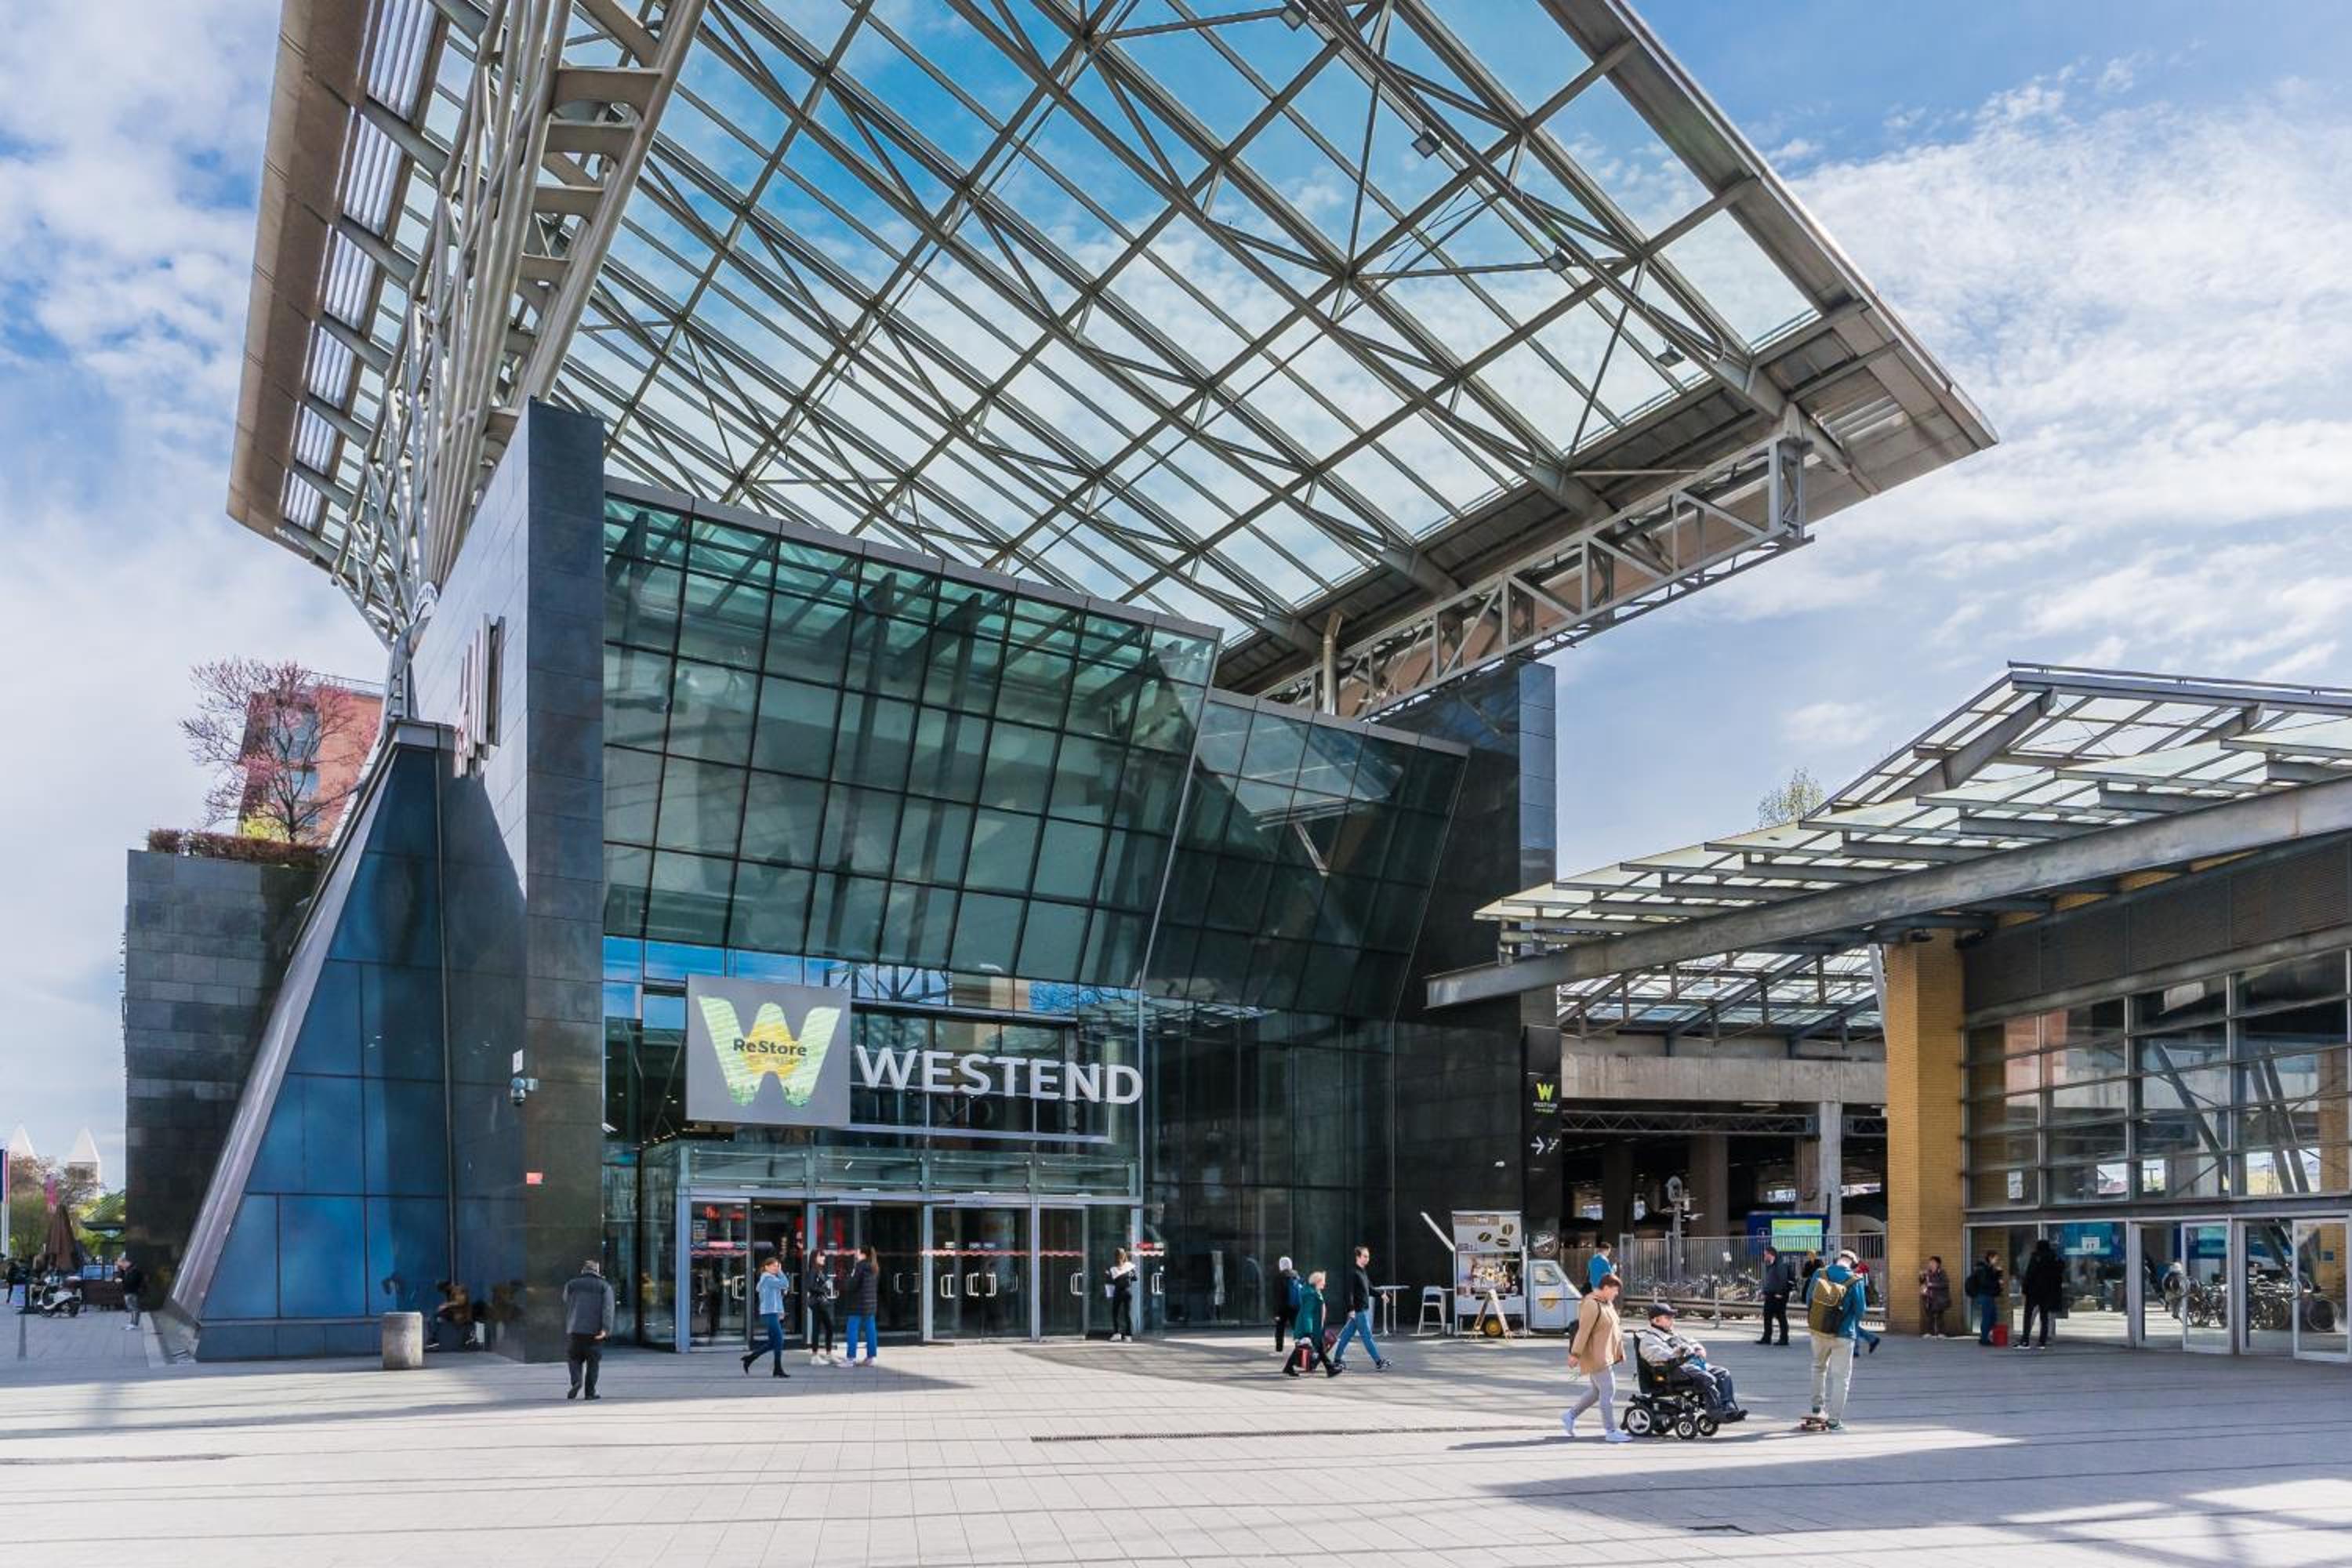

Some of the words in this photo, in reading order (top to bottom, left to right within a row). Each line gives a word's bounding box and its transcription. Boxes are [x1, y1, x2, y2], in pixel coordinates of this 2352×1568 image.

[698, 995, 840, 1107] W
[733, 1037, 808, 1056] ReStore
[855, 1044, 1143, 1104] WESTEND
[1537, 1083, 1555, 1102] W
